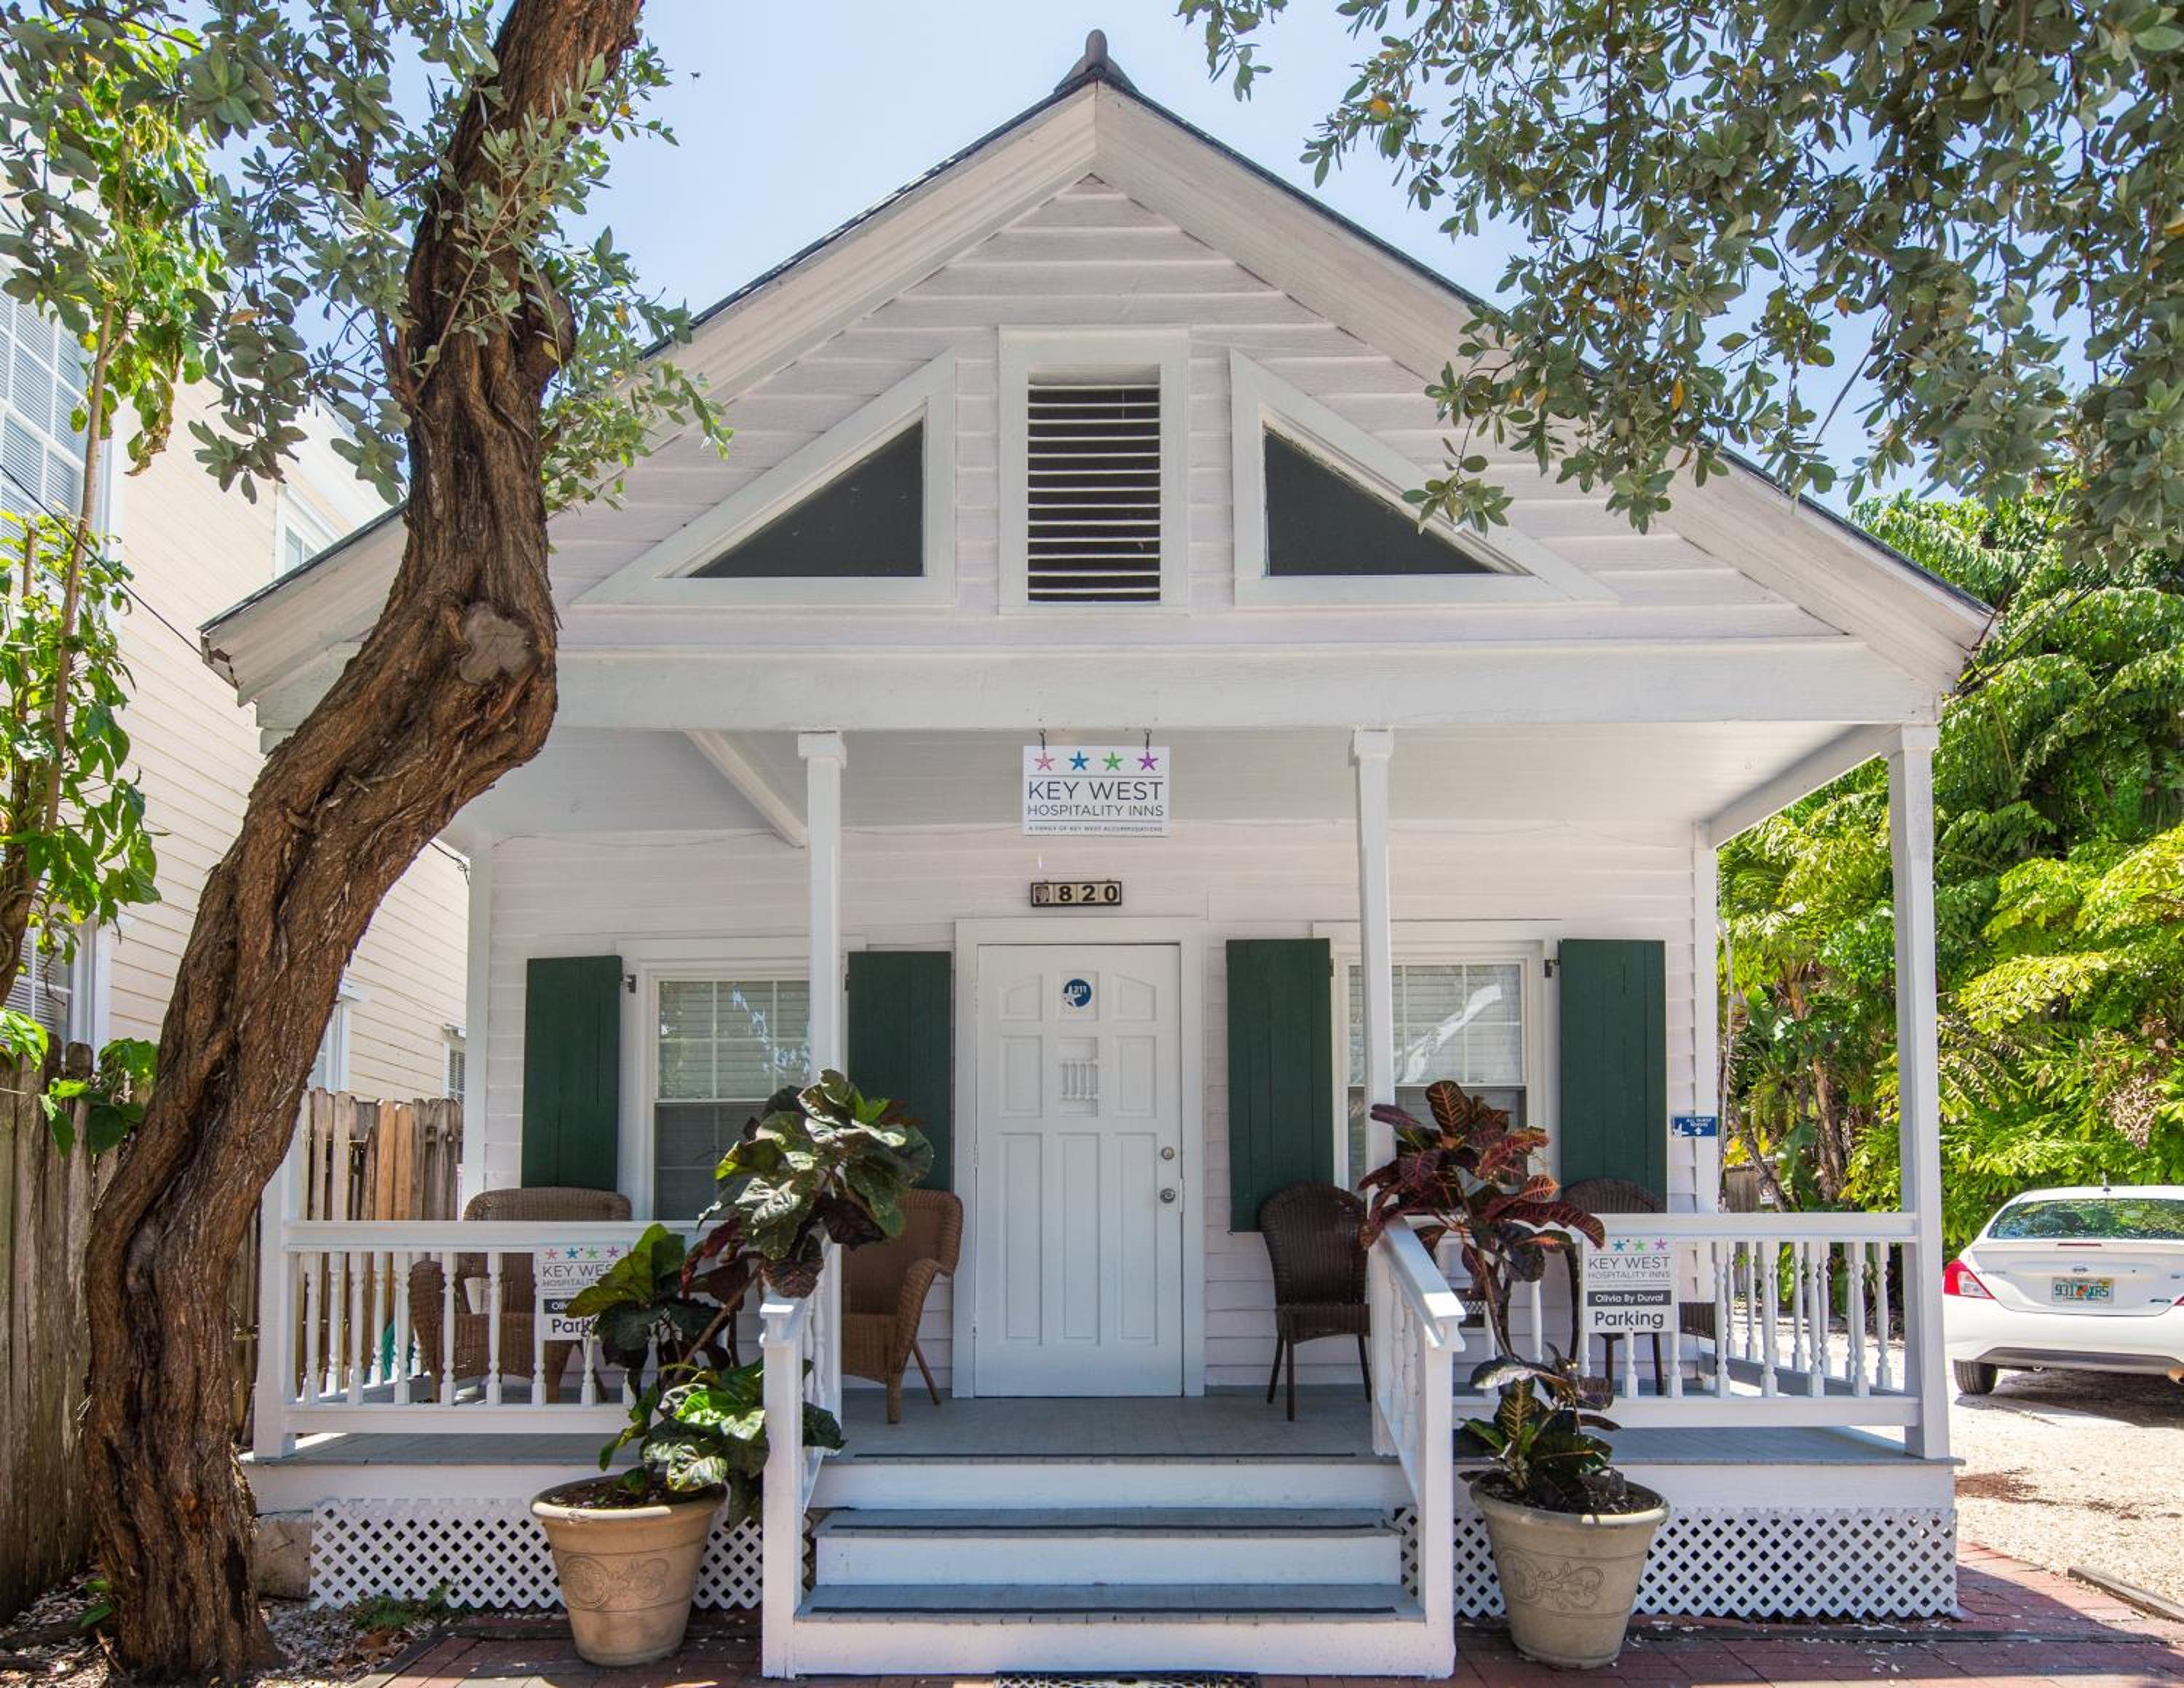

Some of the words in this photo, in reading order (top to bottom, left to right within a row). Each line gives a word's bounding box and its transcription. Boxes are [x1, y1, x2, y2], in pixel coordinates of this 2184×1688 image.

[1029, 781, 1079, 800] KEY
[1089, 781, 1163, 800] WEST
[1028, 805, 1123, 816] HOSPITALITY
[1129, 805, 1163, 816] INNS
[1588, 1258, 1619, 1269] KEY
[1624, 1257, 1671, 1269] WEST
[542, 1266, 573, 1277] KEY
[579, 1264, 613, 1276] WES
[542, 1279, 595, 1287] HOSPITALIT
[1595, 1294, 1622, 1303] Olivia
[1624, 1294, 1635, 1304] By
[1637, 1293, 1663, 1302] Duval
[1594, 1311, 1664, 1329] Parking
